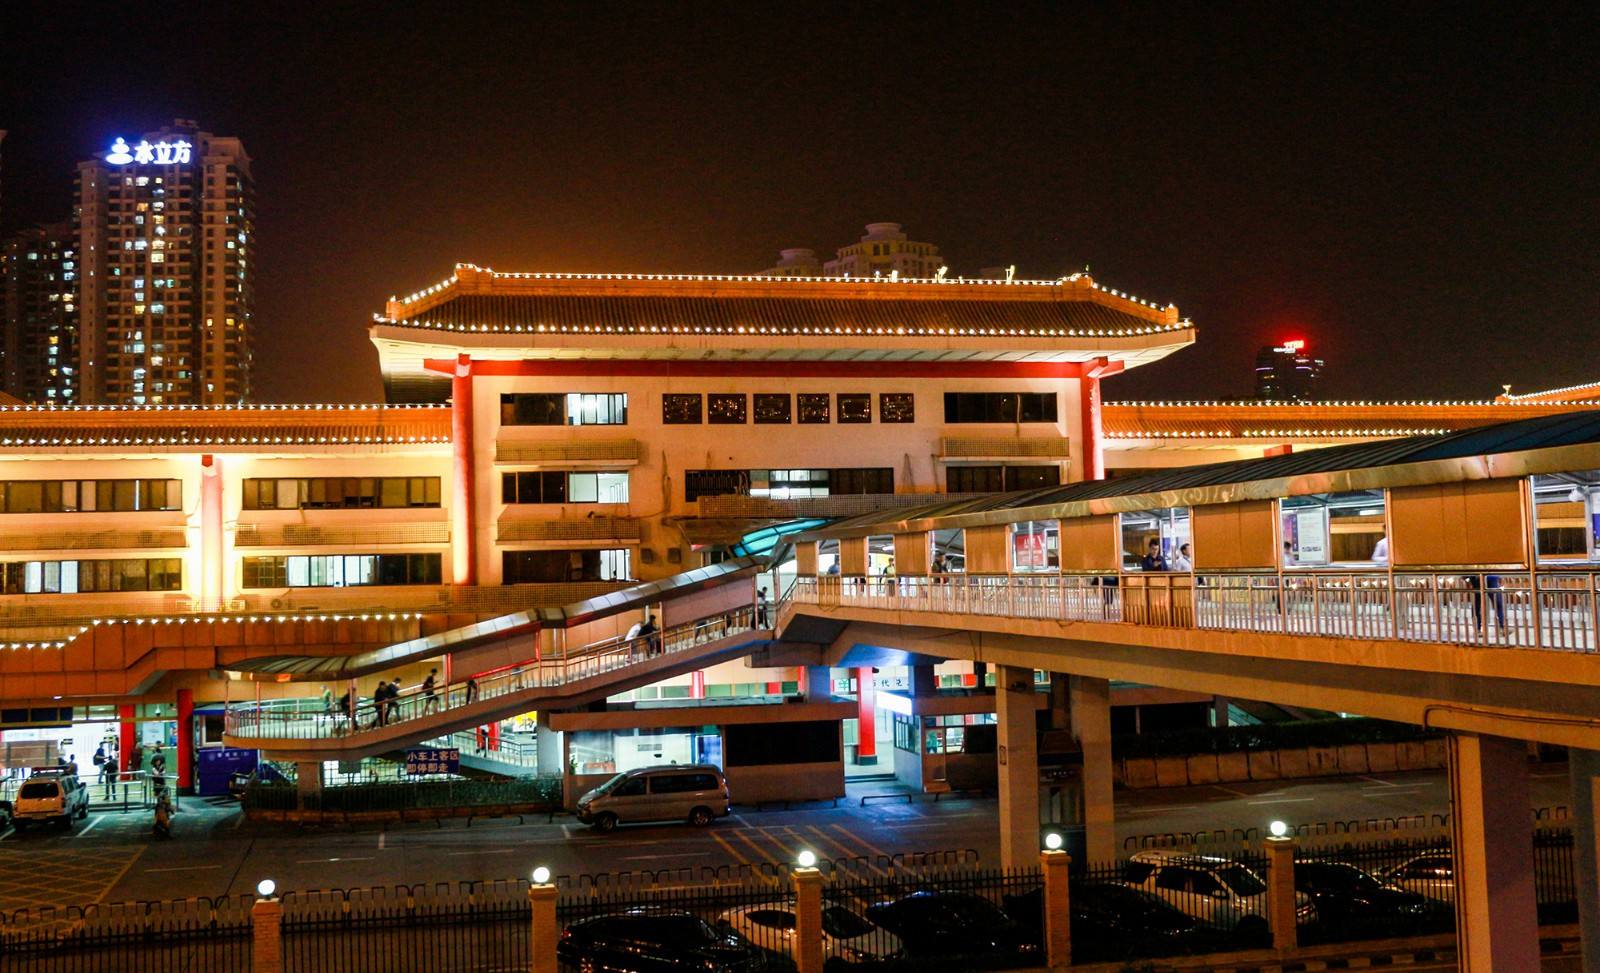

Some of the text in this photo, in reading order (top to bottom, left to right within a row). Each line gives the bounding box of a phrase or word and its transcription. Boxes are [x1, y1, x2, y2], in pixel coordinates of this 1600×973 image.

[134, 140, 192, 164] 水立方
[407, 751, 458, 761] 小车上客区
[407, 763, 449, 773] 即停即走
